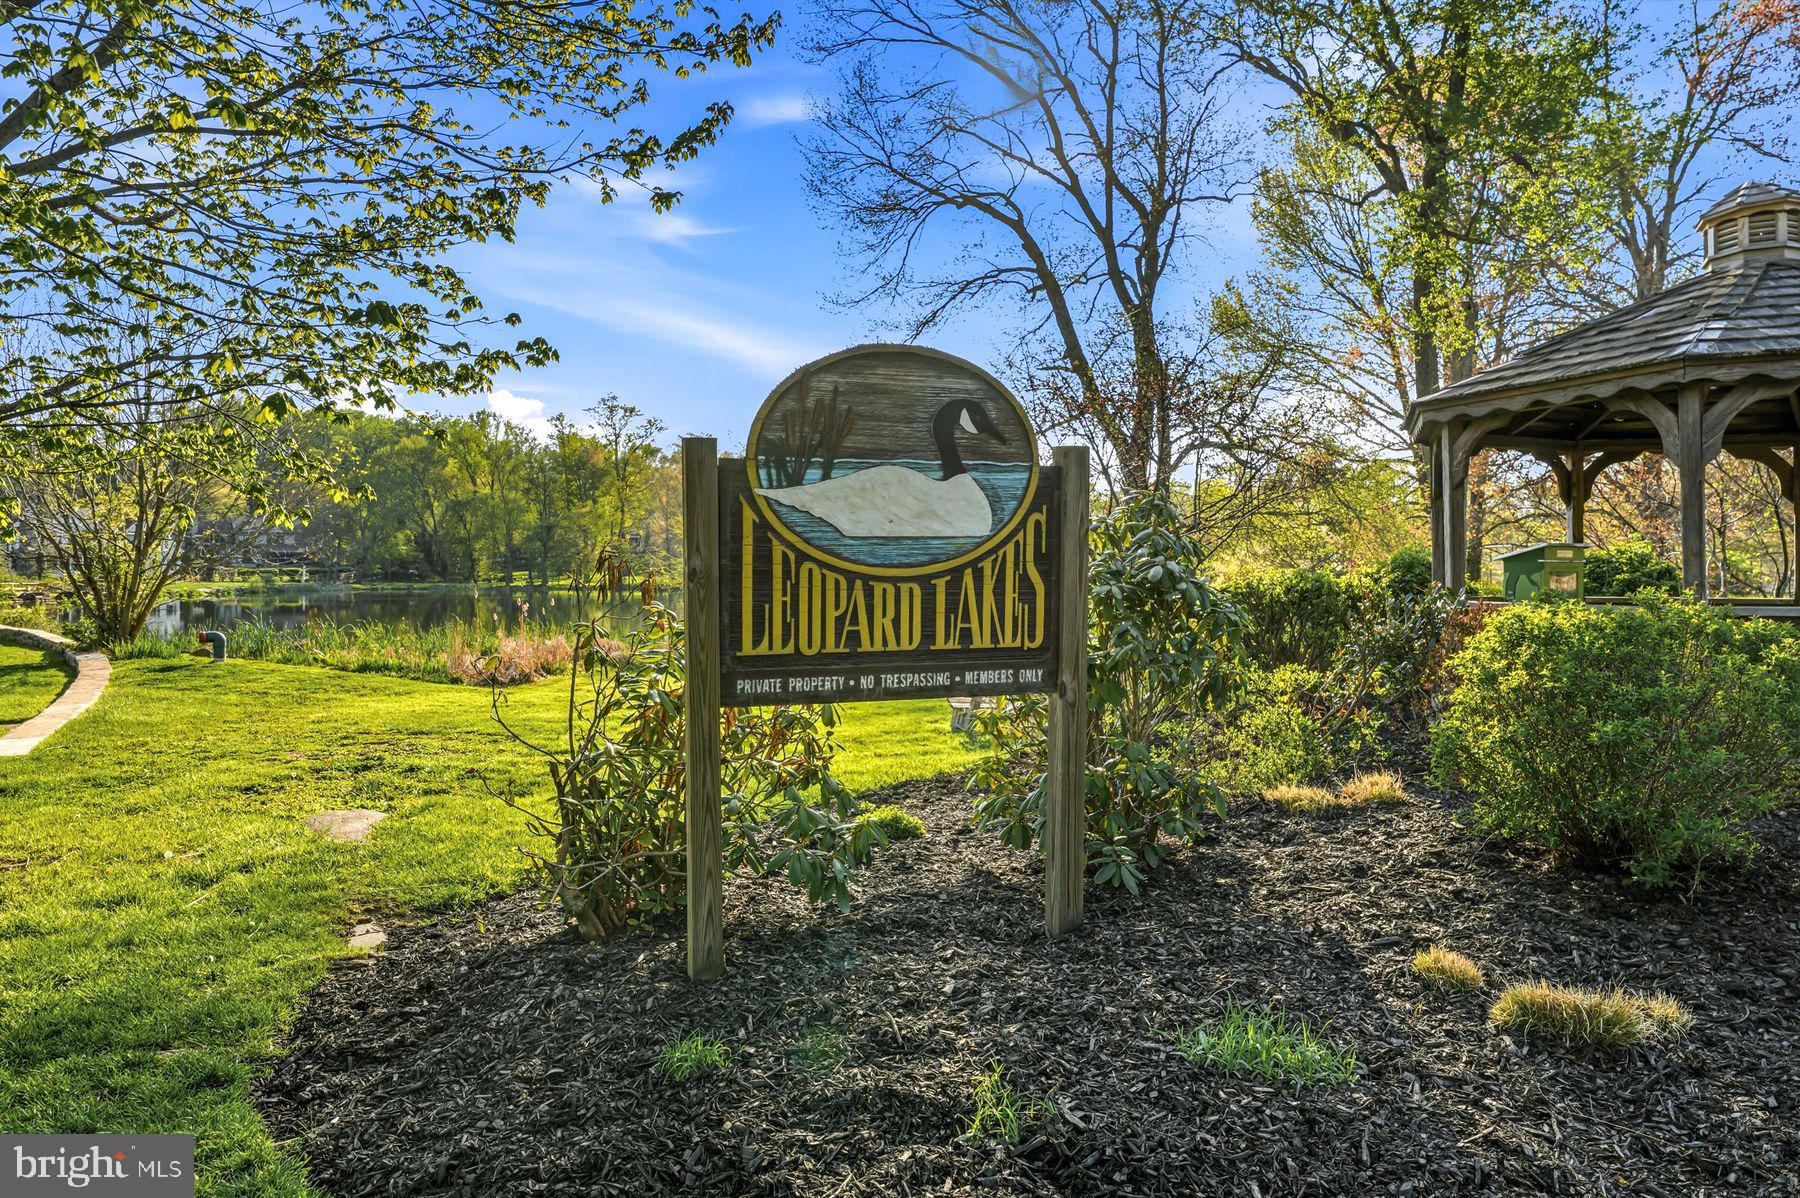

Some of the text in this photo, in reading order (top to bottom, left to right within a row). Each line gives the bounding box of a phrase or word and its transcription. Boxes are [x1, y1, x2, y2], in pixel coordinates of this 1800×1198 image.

[736, 494, 1046, 656] LEOPARD LAKES
[736, 669, 1044, 694] PRIVATE PROPERTY NO TRESPASSING MEMBERS ONLY
